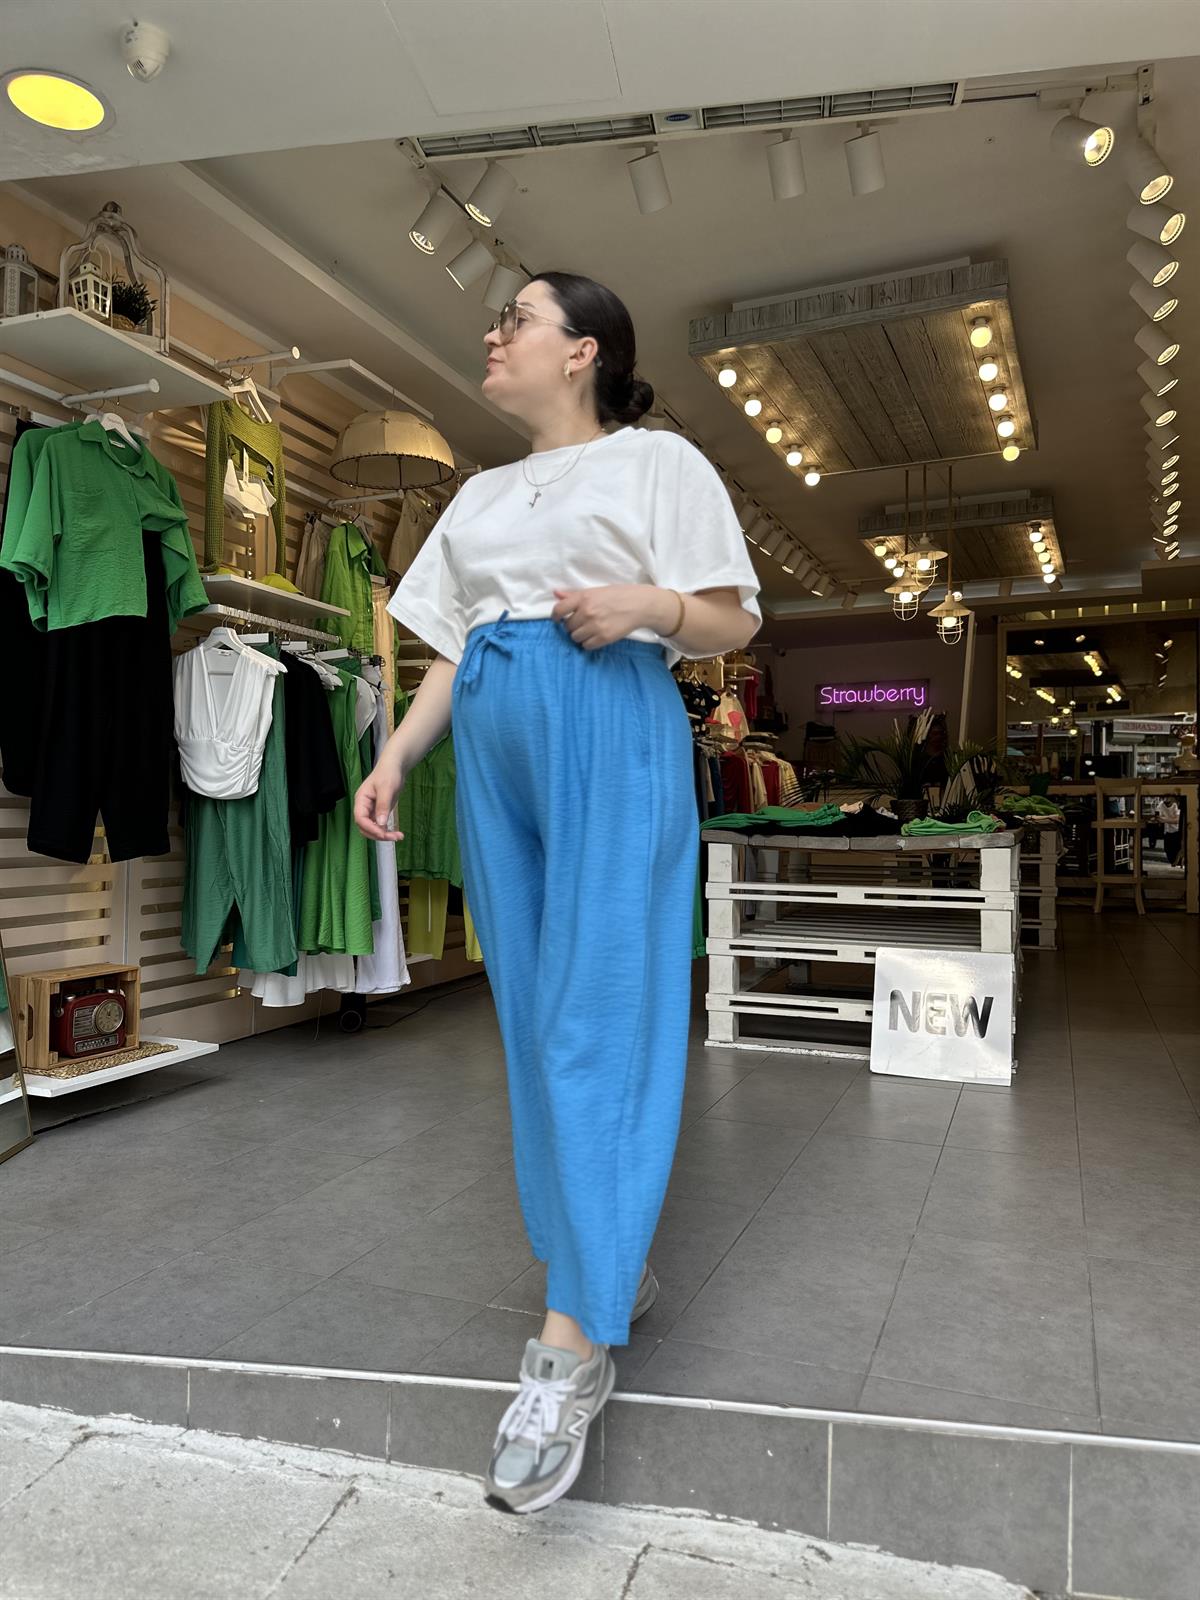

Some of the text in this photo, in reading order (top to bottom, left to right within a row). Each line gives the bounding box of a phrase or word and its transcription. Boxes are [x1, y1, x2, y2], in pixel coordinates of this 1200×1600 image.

[820, 684, 925, 706] Strawberry
[888, 989, 994, 1039] NEW
[567, 1408, 590, 1439] N
